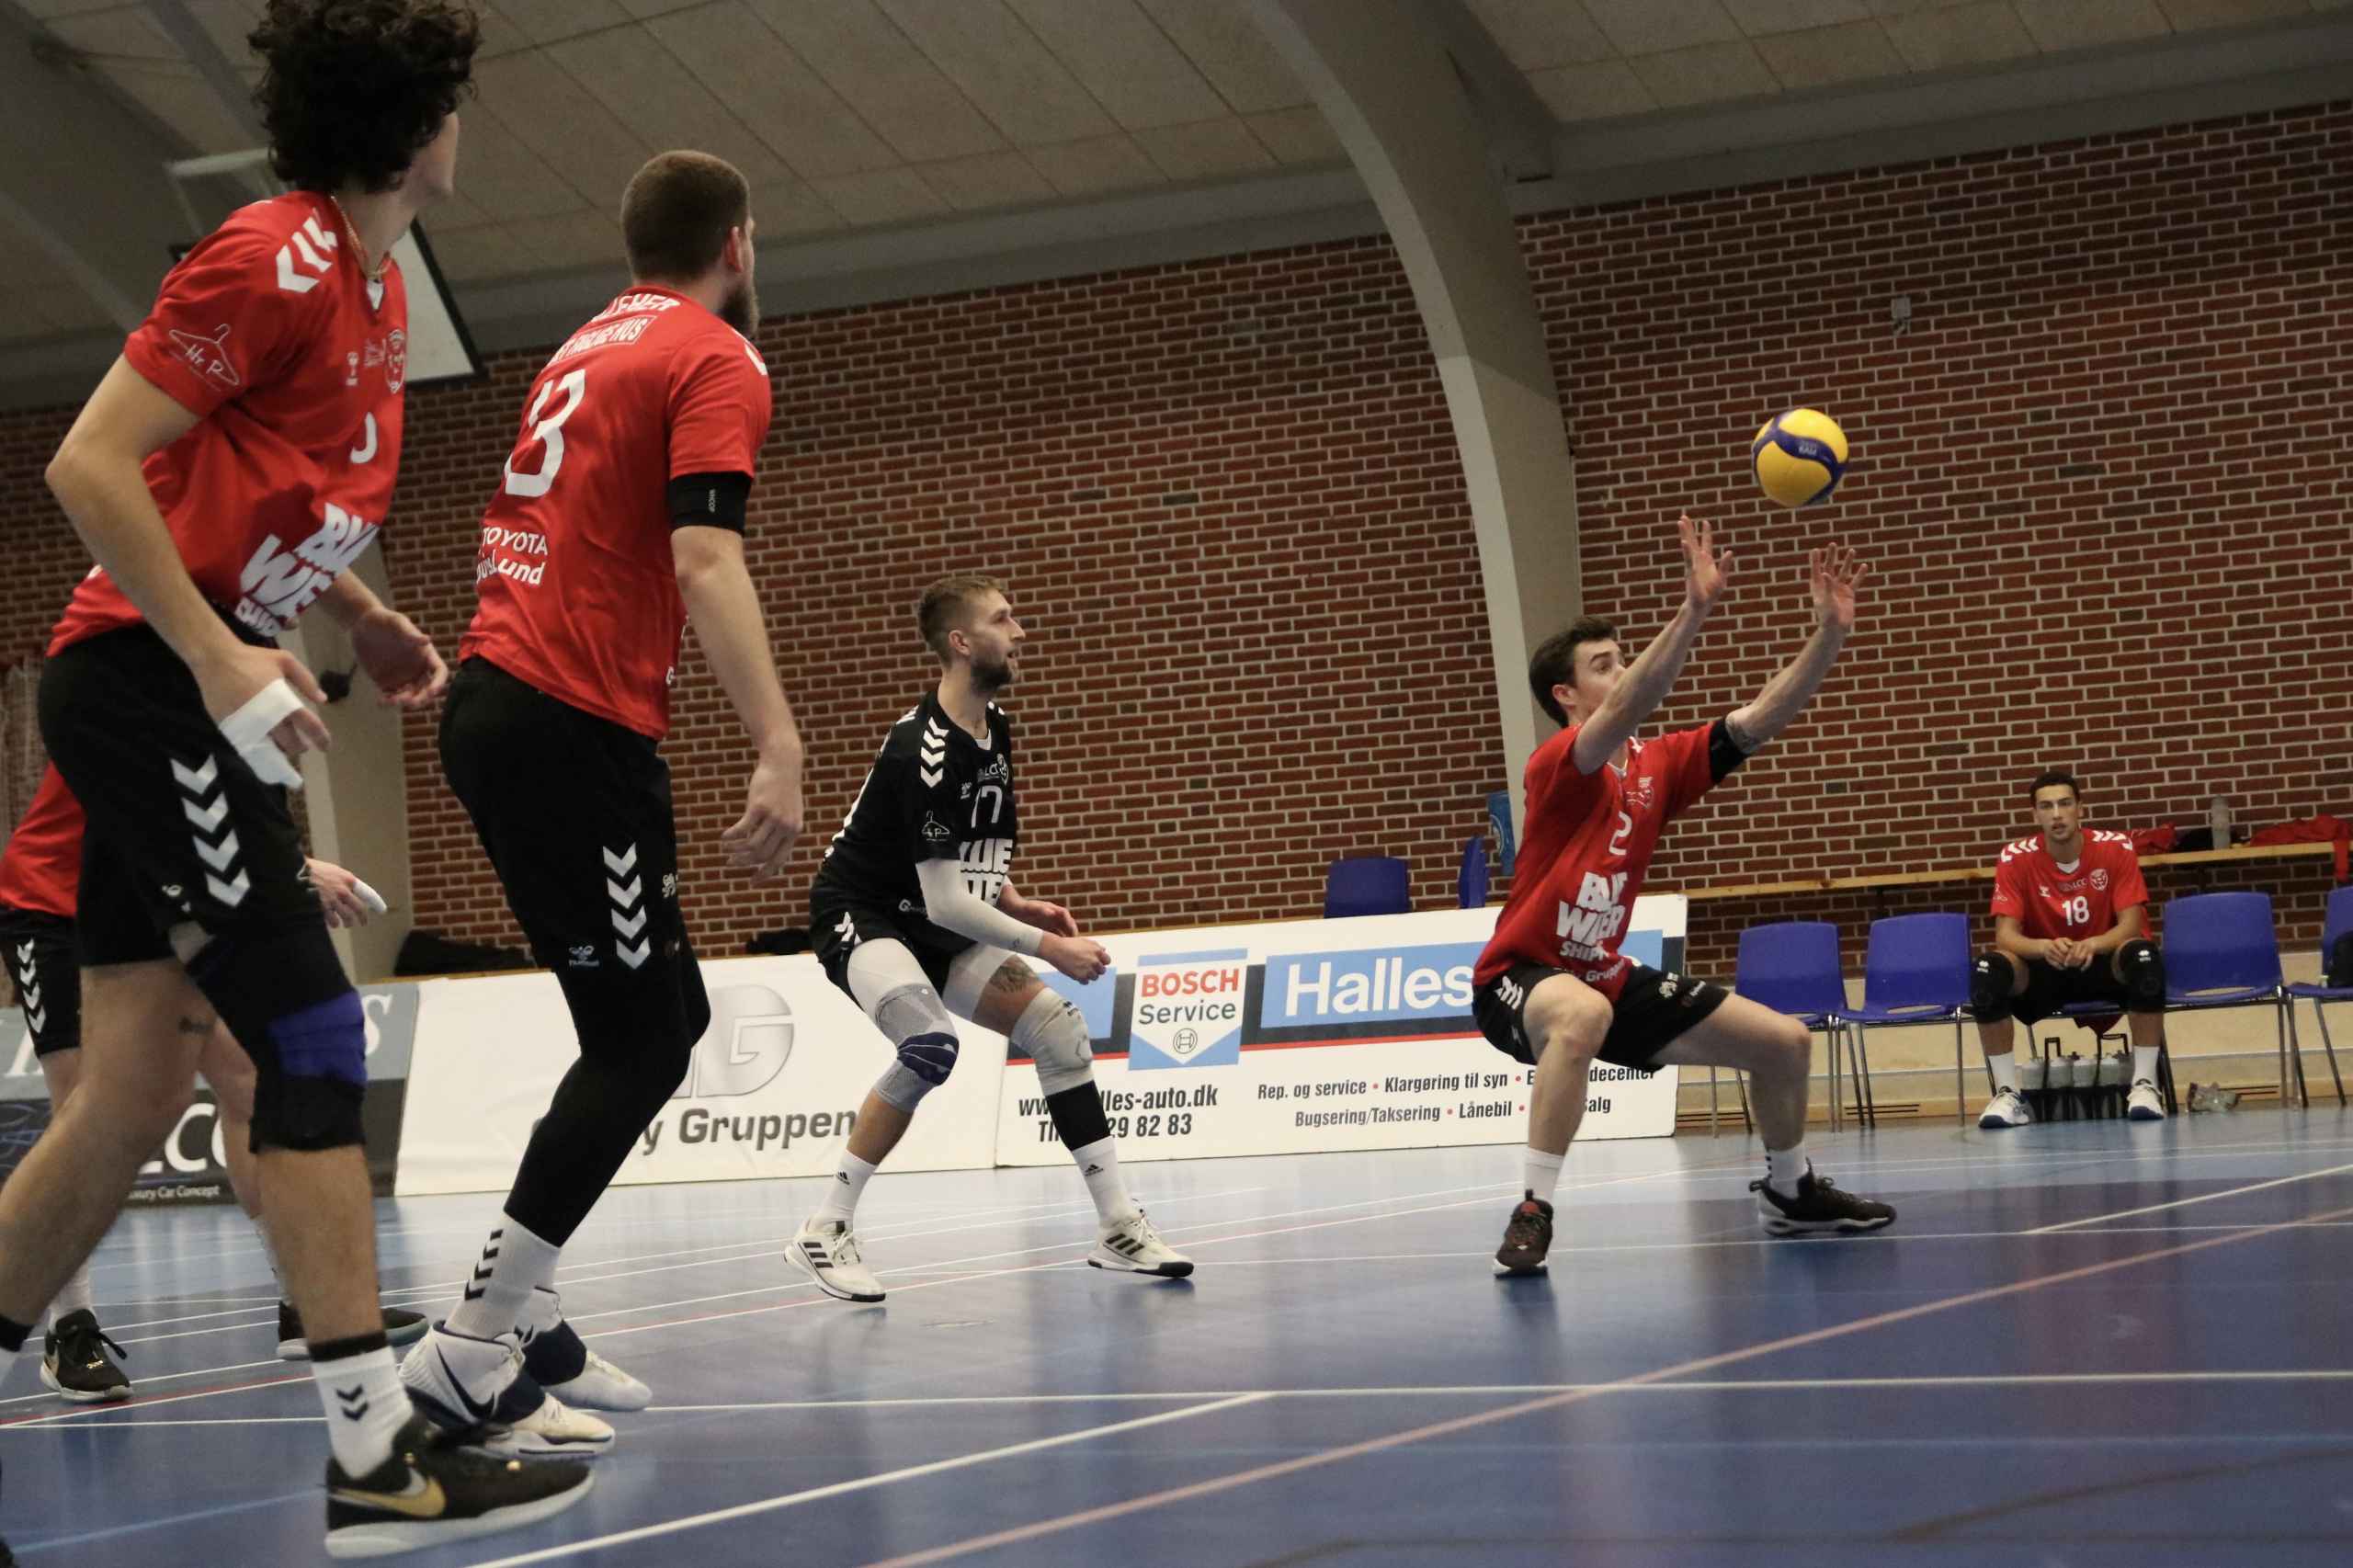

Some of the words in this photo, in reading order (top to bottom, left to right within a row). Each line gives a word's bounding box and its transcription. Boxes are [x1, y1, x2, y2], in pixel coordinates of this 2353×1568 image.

[483, 527, 549, 556] TOYOTA
[1608, 811, 1632, 857] 2
[2062, 895, 2090, 926] 18
[1140, 968, 1240, 998] BOSCH
[1284, 956, 1474, 1017] Halles
[1138, 998, 1237, 1026] Service
[1257, 1084, 1289, 1101] Rep.
[1293, 1084, 1311, 1100] og
[1314, 1079, 1367, 1096] service
[1384, 1073, 1461, 1094] Klargøring
[1464, 1073, 1479, 1089] til
[1483, 1074, 1509, 1089] syn
[1135, 1115, 1161, 1138] 82
[1167, 1113, 1193, 1136] 83
[1294, 1105, 1441, 1129] Bugsering/Taksering
[1459, 1100, 1513, 1119] Lånebil
[1584, 1096, 1611, 1115] alg
[678, 1108, 859, 1152] Gruppen
[128, 1188, 157, 1203] uxury
[176, 1185, 221, 1199] Concept
